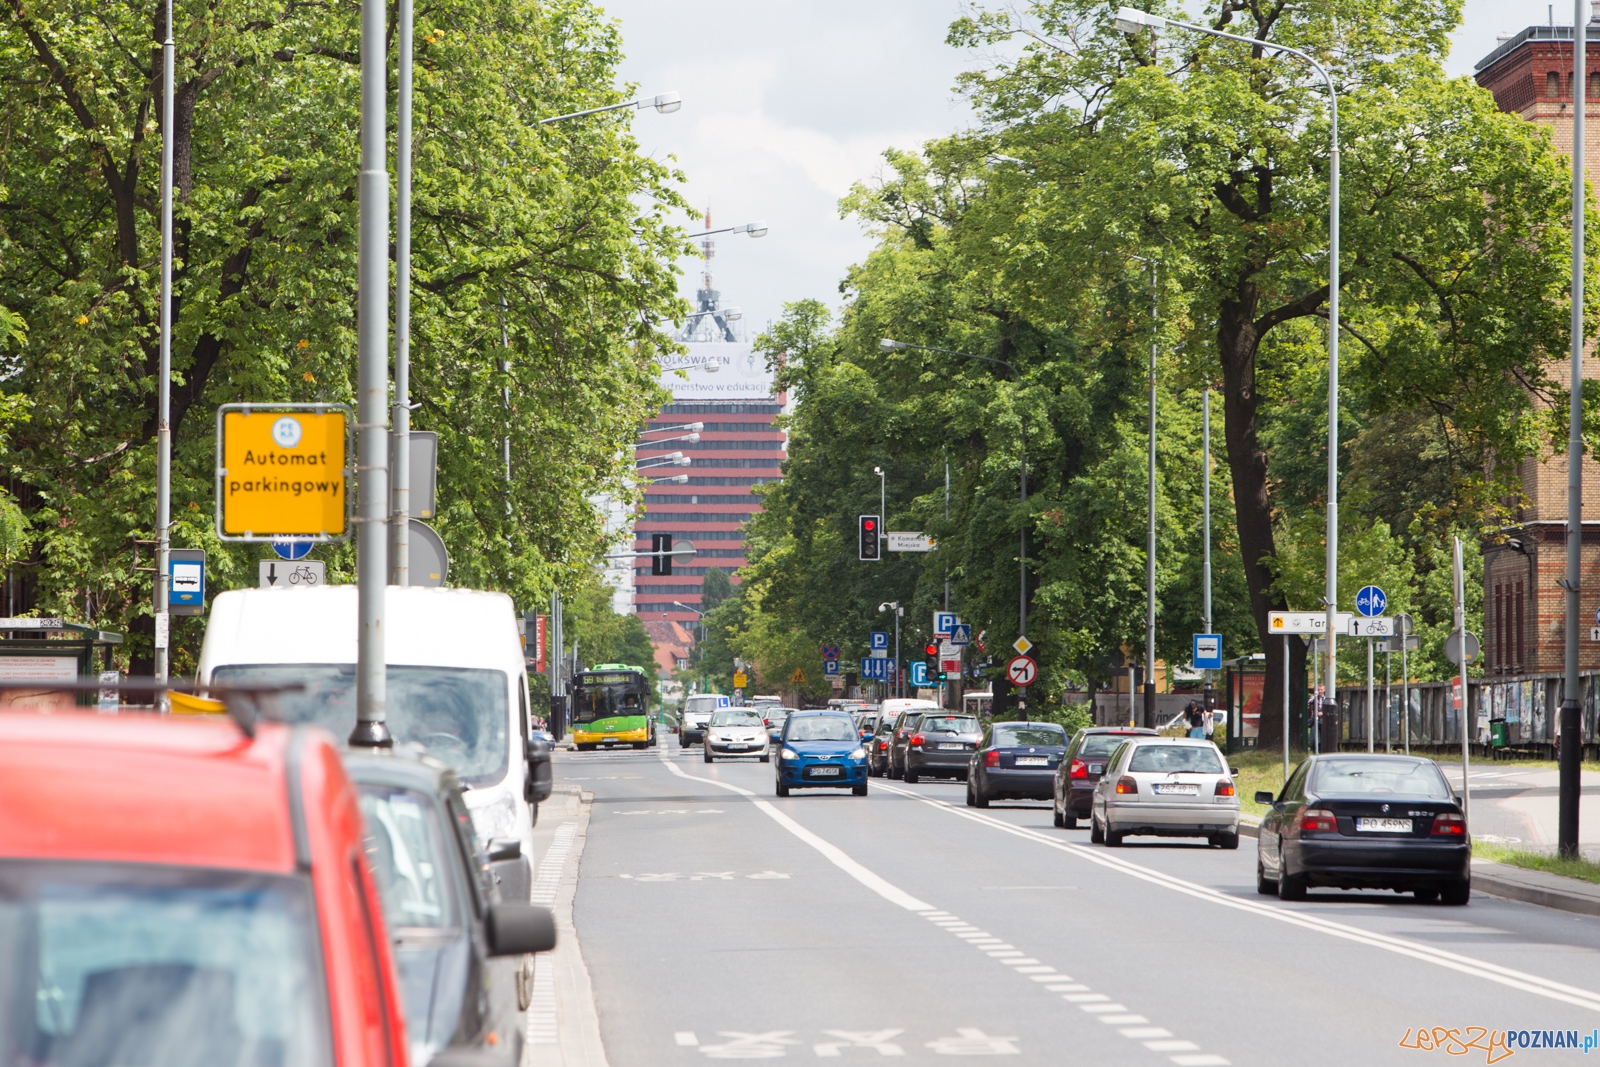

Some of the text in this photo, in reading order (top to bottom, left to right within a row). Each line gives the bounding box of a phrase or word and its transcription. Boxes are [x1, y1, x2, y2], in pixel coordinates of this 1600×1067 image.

[717, 383, 726, 391] w
[727, 382, 766, 393] edukacji
[243, 450, 327, 465] Automat
[230, 476, 340, 496] parkingowy
[1308, 618, 1326, 628] Tar
[874, 634, 885, 648] P
[720, 698, 727, 707] L
[1362, 819, 1411, 830] PO 459NS
